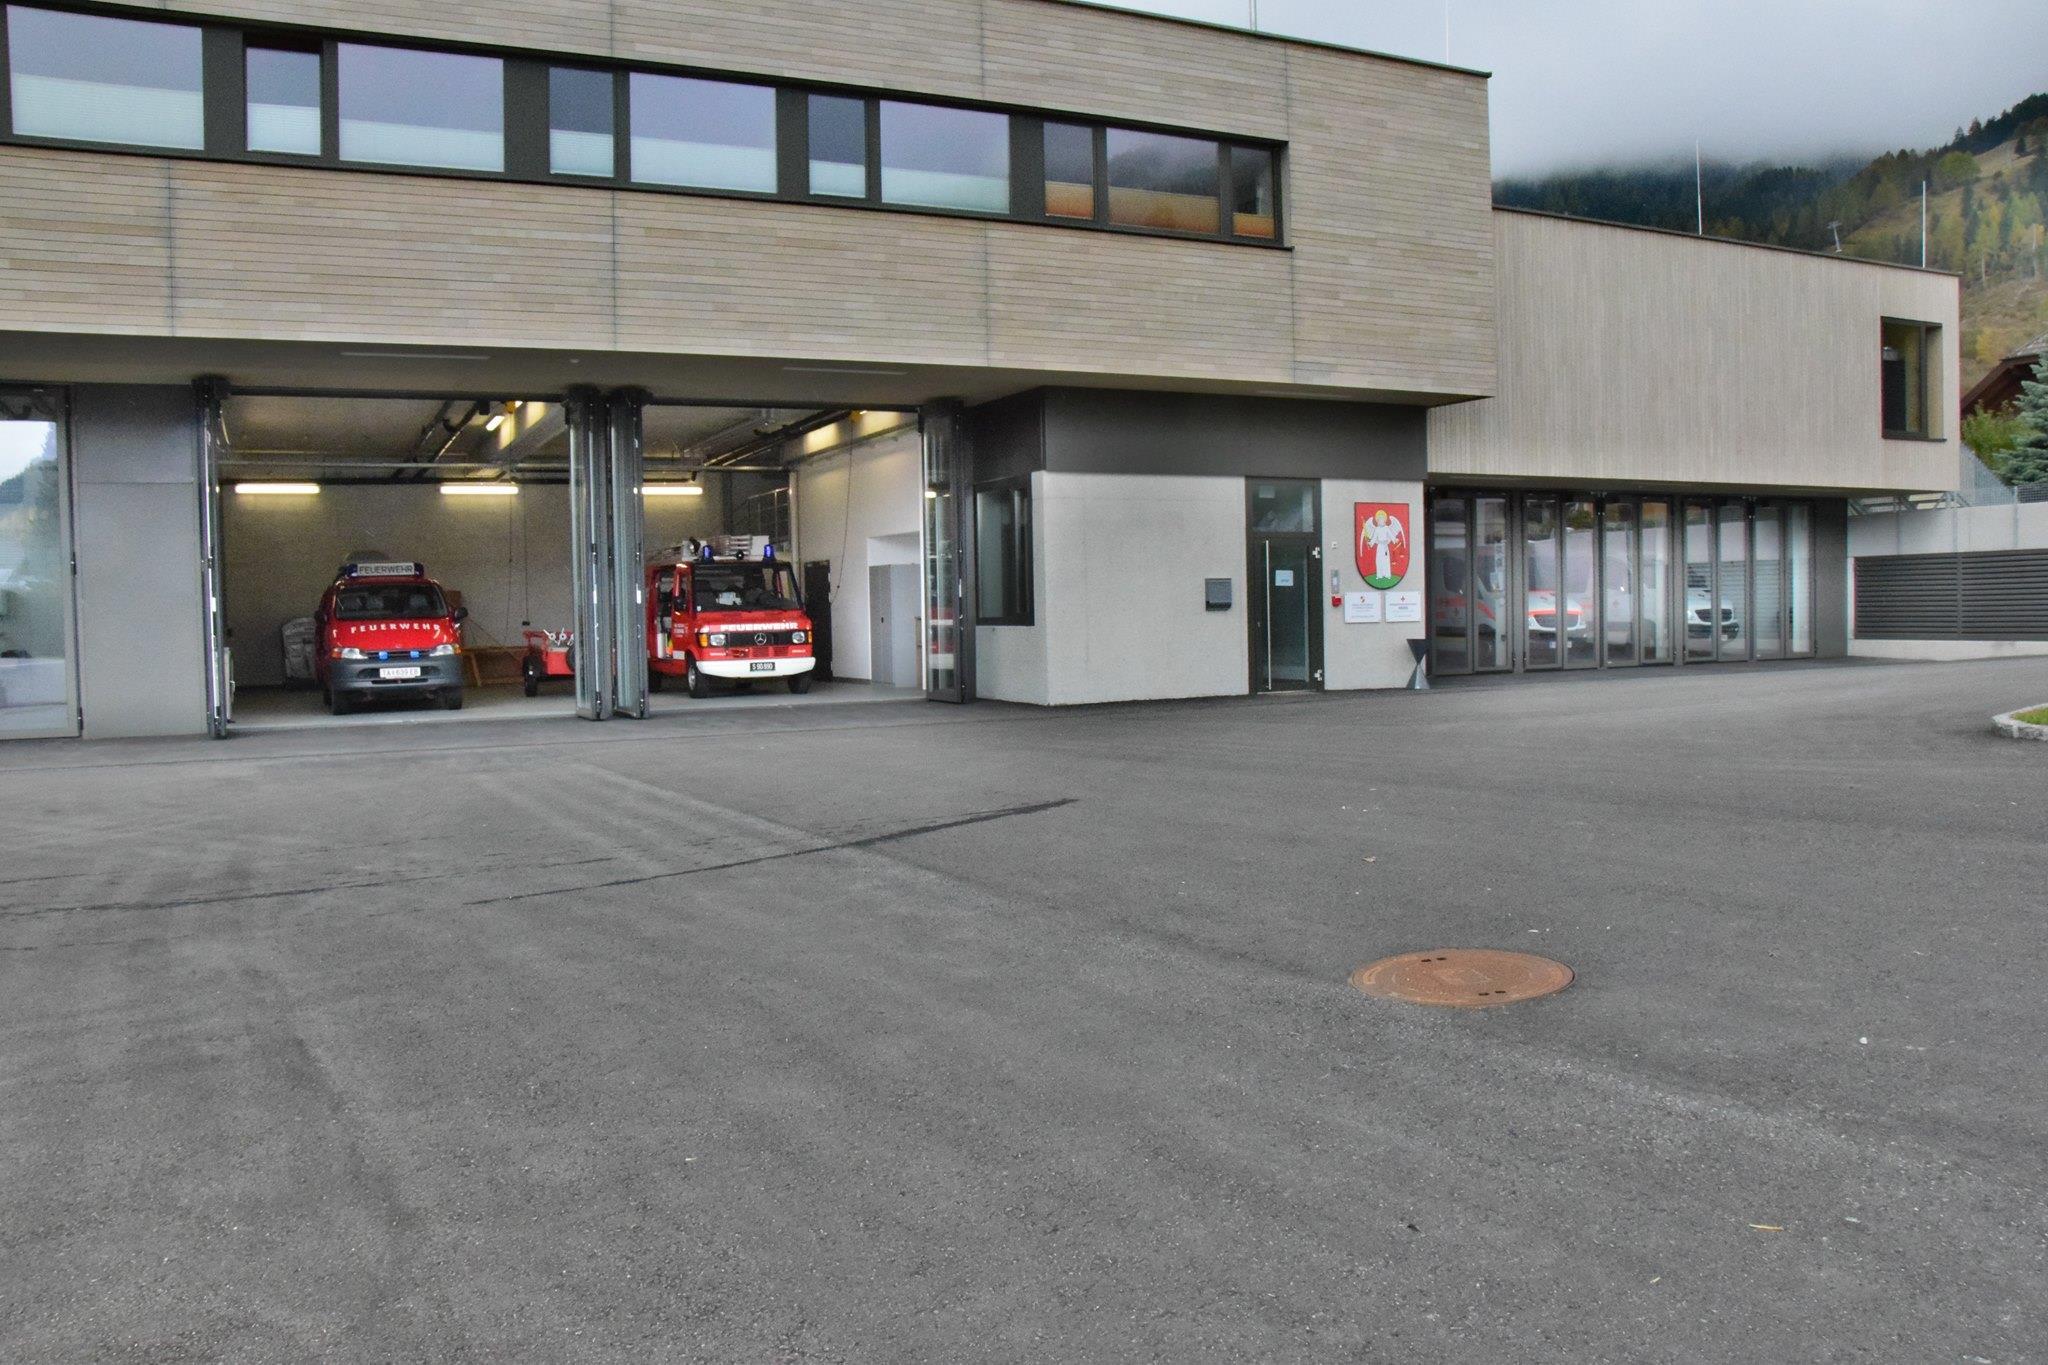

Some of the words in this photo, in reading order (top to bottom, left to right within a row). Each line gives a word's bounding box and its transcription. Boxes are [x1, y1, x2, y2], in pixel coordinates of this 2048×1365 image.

[359, 565, 413, 574] FEUERWEHR
[350, 623, 440, 634] FEUERWEHR
[720, 622, 799, 632] FEUERWEHR
